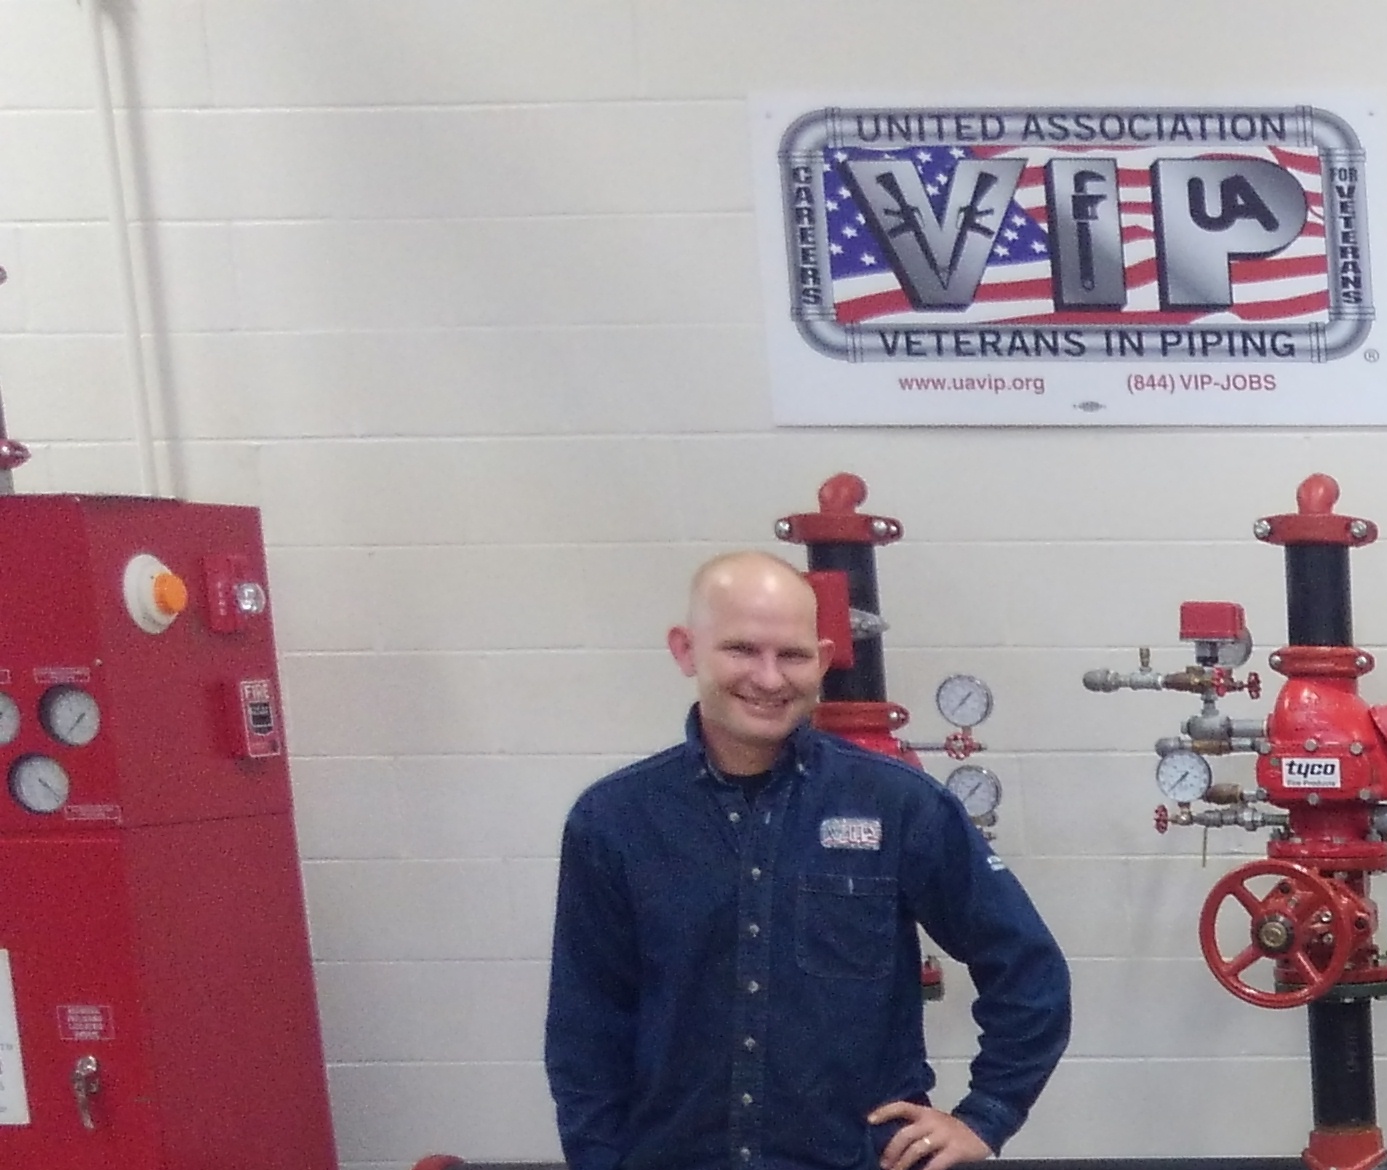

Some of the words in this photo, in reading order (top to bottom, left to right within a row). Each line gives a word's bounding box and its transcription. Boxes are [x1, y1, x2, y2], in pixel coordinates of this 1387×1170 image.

[857, 113, 1006, 141] UNITED
[1020, 112, 1288, 141] ASSOCIATION
[1329, 167, 1358, 182] FOR
[1187, 174, 1280, 232] UA
[792, 165, 823, 305] CAREERS
[838, 157, 1308, 312] VIP
[1335, 185, 1363, 304] VETERANS
[879, 330, 1087, 358] VETERANS
[1105, 330, 1144, 356] IN
[1160, 330, 1296, 357] PIPING
[898, 374, 1045, 394] www.uavip.org
[1126, 373, 1175, 394] (844)
[1179, 374, 1277, 391] VIP-JOBS
[1285, 760, 1336, 778] tyco
